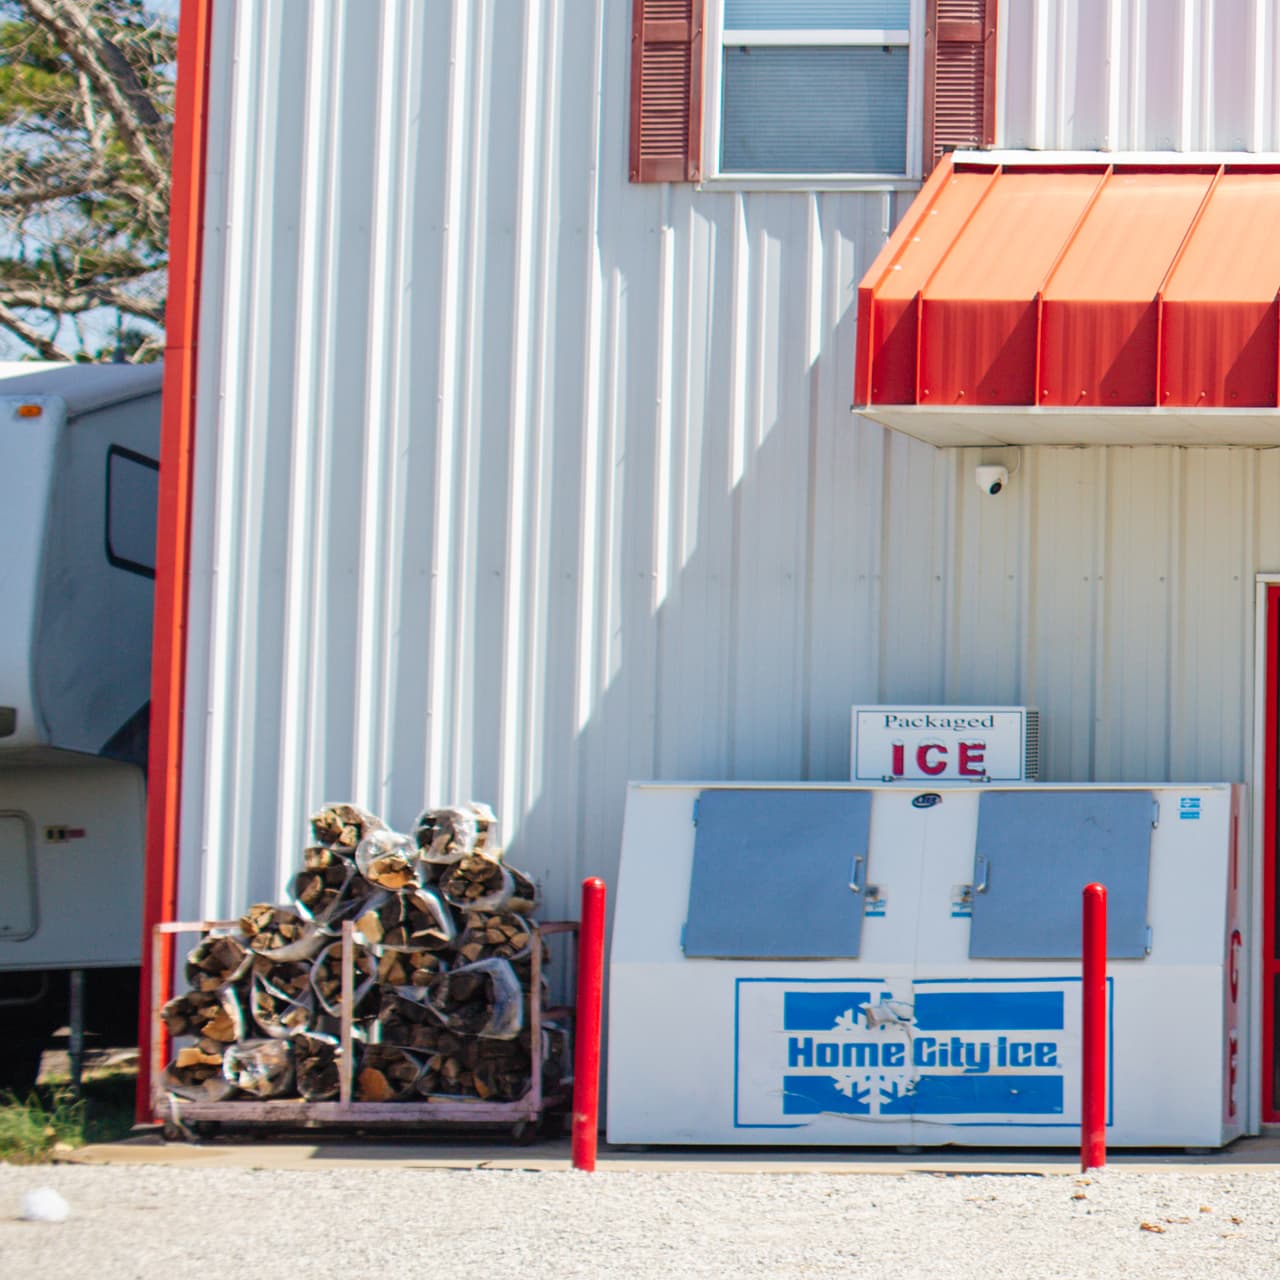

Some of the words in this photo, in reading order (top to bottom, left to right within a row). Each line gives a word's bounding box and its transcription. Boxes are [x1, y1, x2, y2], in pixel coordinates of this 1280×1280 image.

[884, 714, 995, 732] Packaged
[891, 738, 988, 777] ICE
[787, 1036, 906, 1068] Home
[913, 1036, 991, 1074] City
[997, 1035, 1059, 1068] Ice
